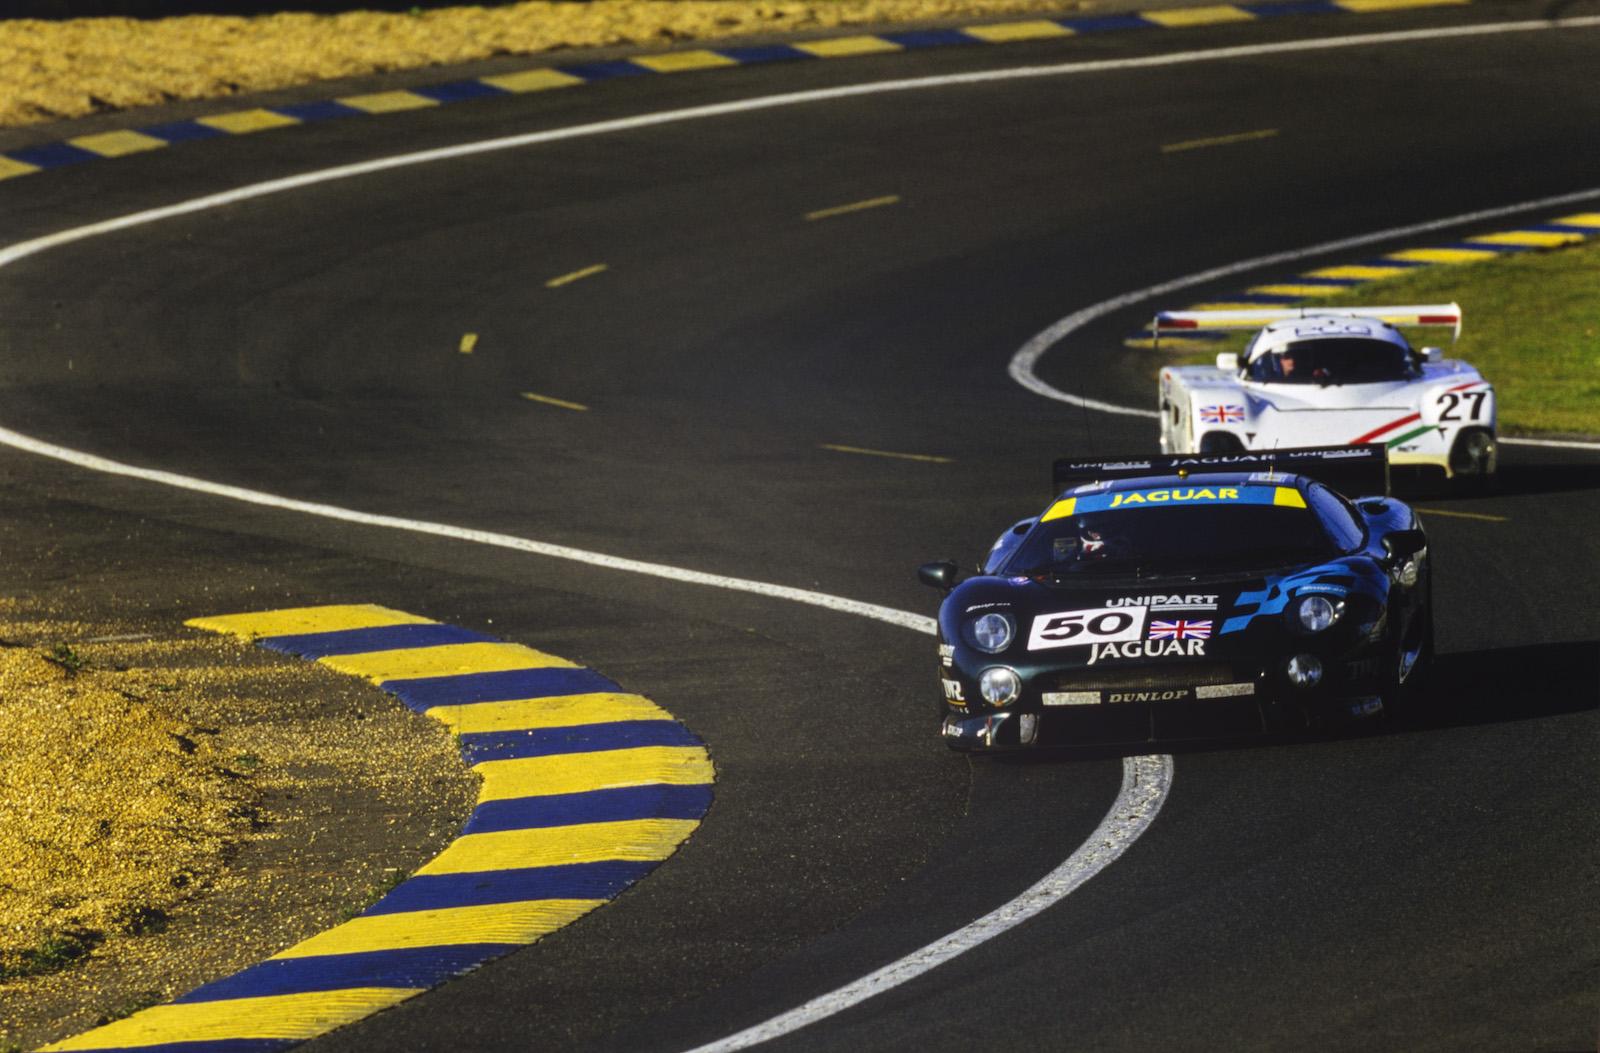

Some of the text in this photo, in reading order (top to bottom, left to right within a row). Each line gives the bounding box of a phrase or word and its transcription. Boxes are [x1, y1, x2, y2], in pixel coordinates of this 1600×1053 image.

[1437, 392, 1486, 421] 27
[1171, 454, 1277, 467] JAGUAR
[1110, 488, 1239, 508] JAGUAR
[1106, 594, 1219, 609] UNIPART
[1040, 612, 1133, 641] 50
[1087, 638, 1205, 665] JAGUAR
[1109, 690, 1189, 703] DUNLOP
